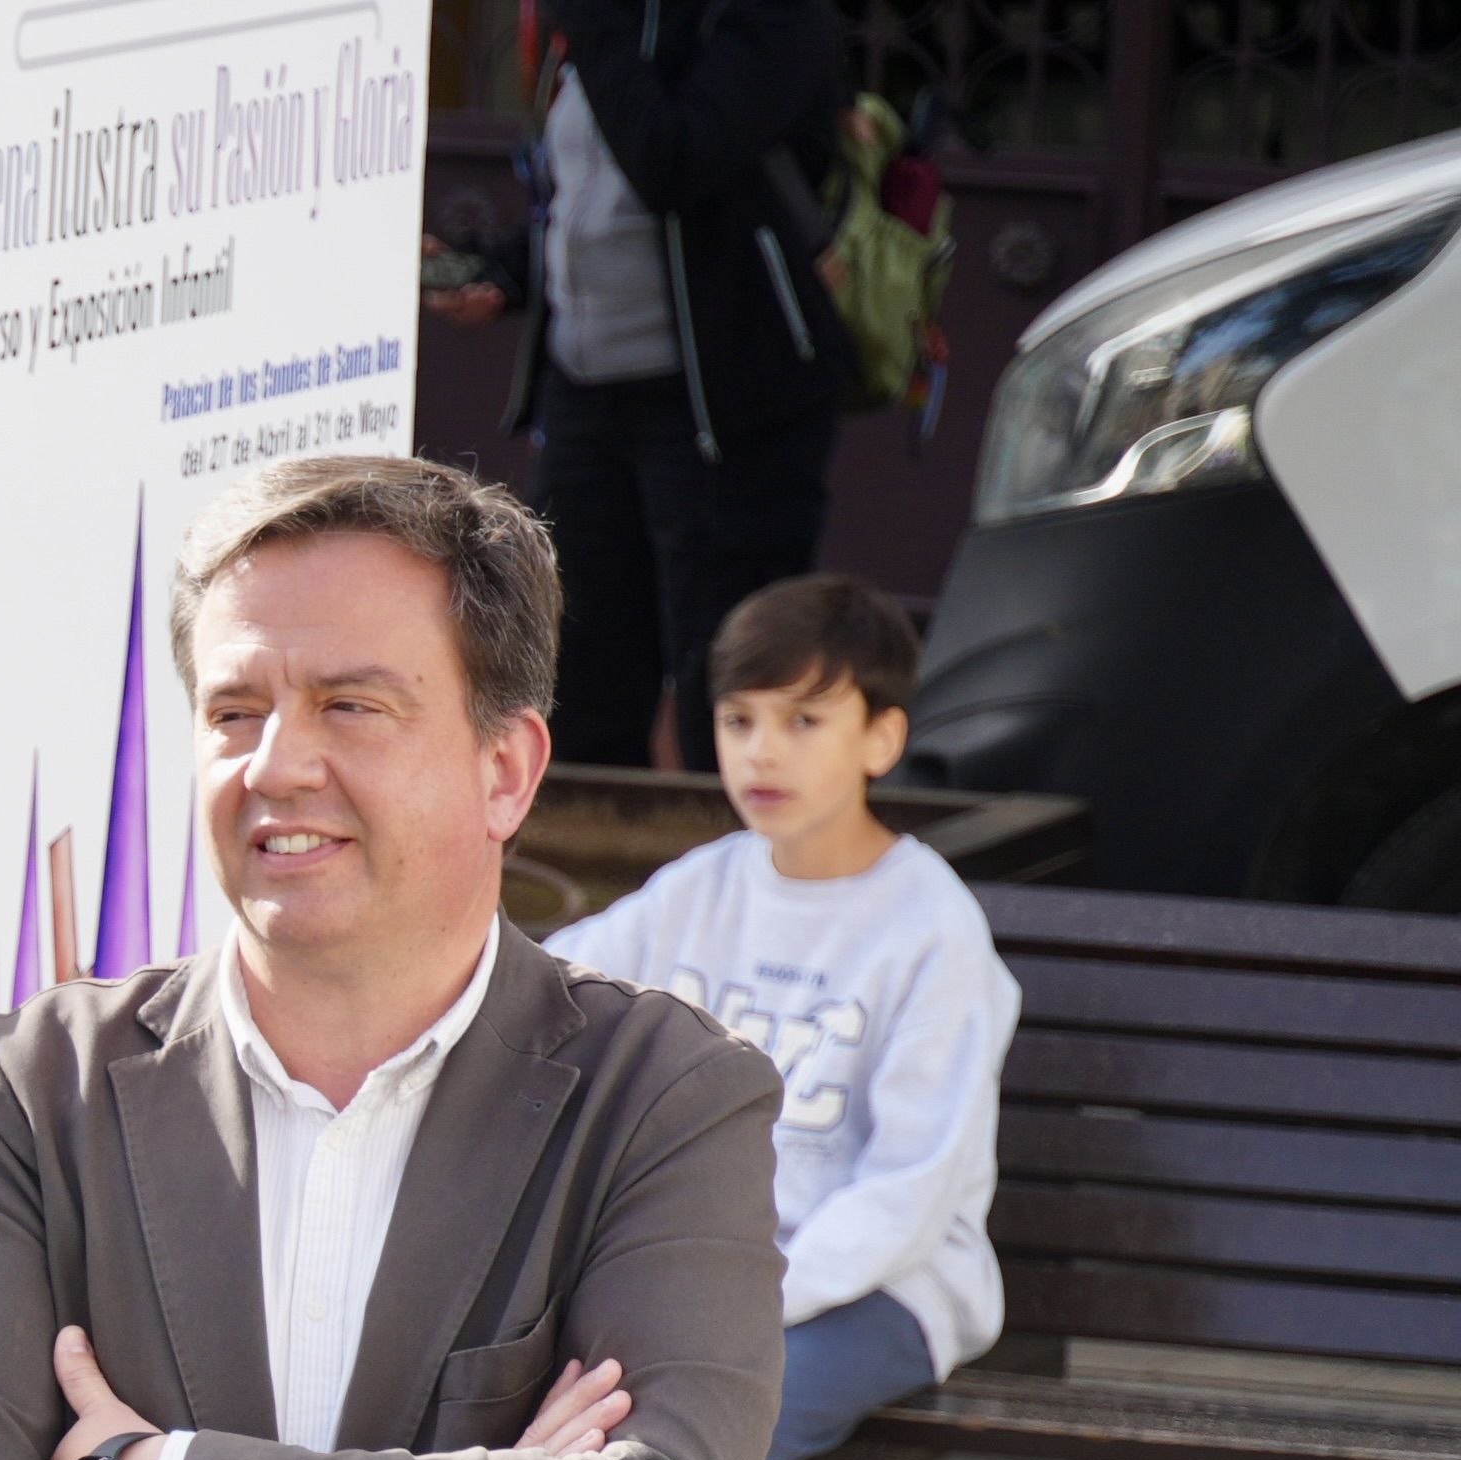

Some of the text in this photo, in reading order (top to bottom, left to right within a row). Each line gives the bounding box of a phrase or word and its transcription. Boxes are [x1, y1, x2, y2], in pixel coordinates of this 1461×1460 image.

[46, 87, 160, 243] ilustra
[168, 108, 206, 217] su
[209, 62, 305, 209] Pasión
[307, 84, 329, 220] y
[332, 36, 415, 186] Gloria
[28, 304, 43, 374] y
[48, 261, 155, 364] Exposición
[160, 234, 235, 325] Infantil
[161, 335, 402, 422] Palacio de los Condes de Santa Ana
[181, 438, 207, 479] del
[208, 432, 229, 472] 27
[232, 429, 252, 467] de
[257, 417, 293, 458] Abril
[296, 412, 309, 451] al
[335, 401, 354, 442] de
[357, 399, 399, 443] Mayo
